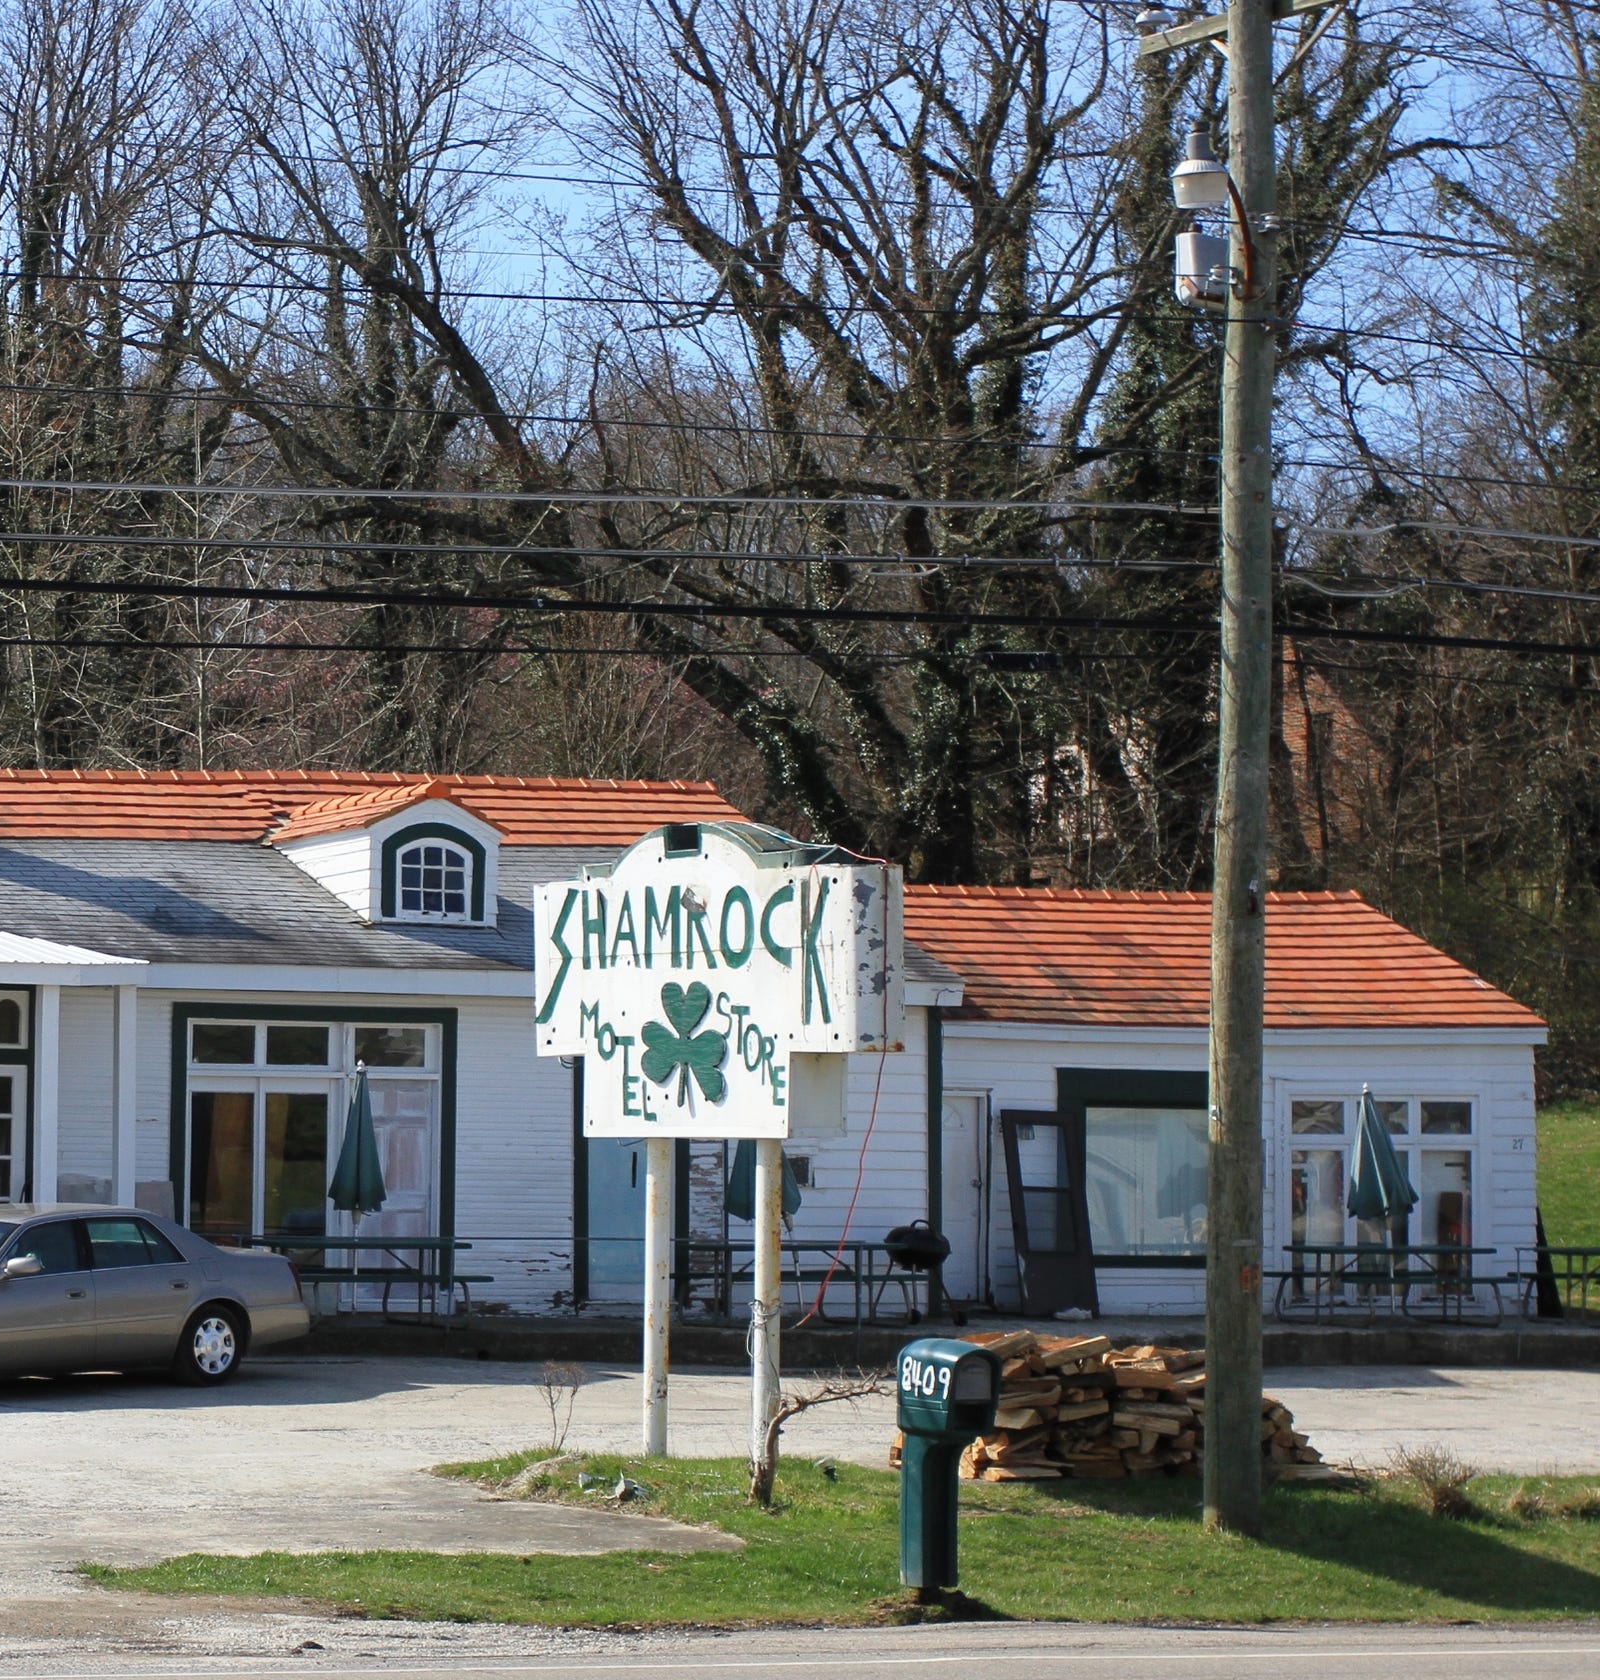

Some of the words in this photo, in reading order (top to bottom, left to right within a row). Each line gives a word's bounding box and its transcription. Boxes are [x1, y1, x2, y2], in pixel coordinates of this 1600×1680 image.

[534, 876, 832, 1025] SHAMROCK
[579, 999, 658, 1122] MOTEL
[716, 991, 786, 1106] STORE
[901, 1355, 951, 1400] 8409
